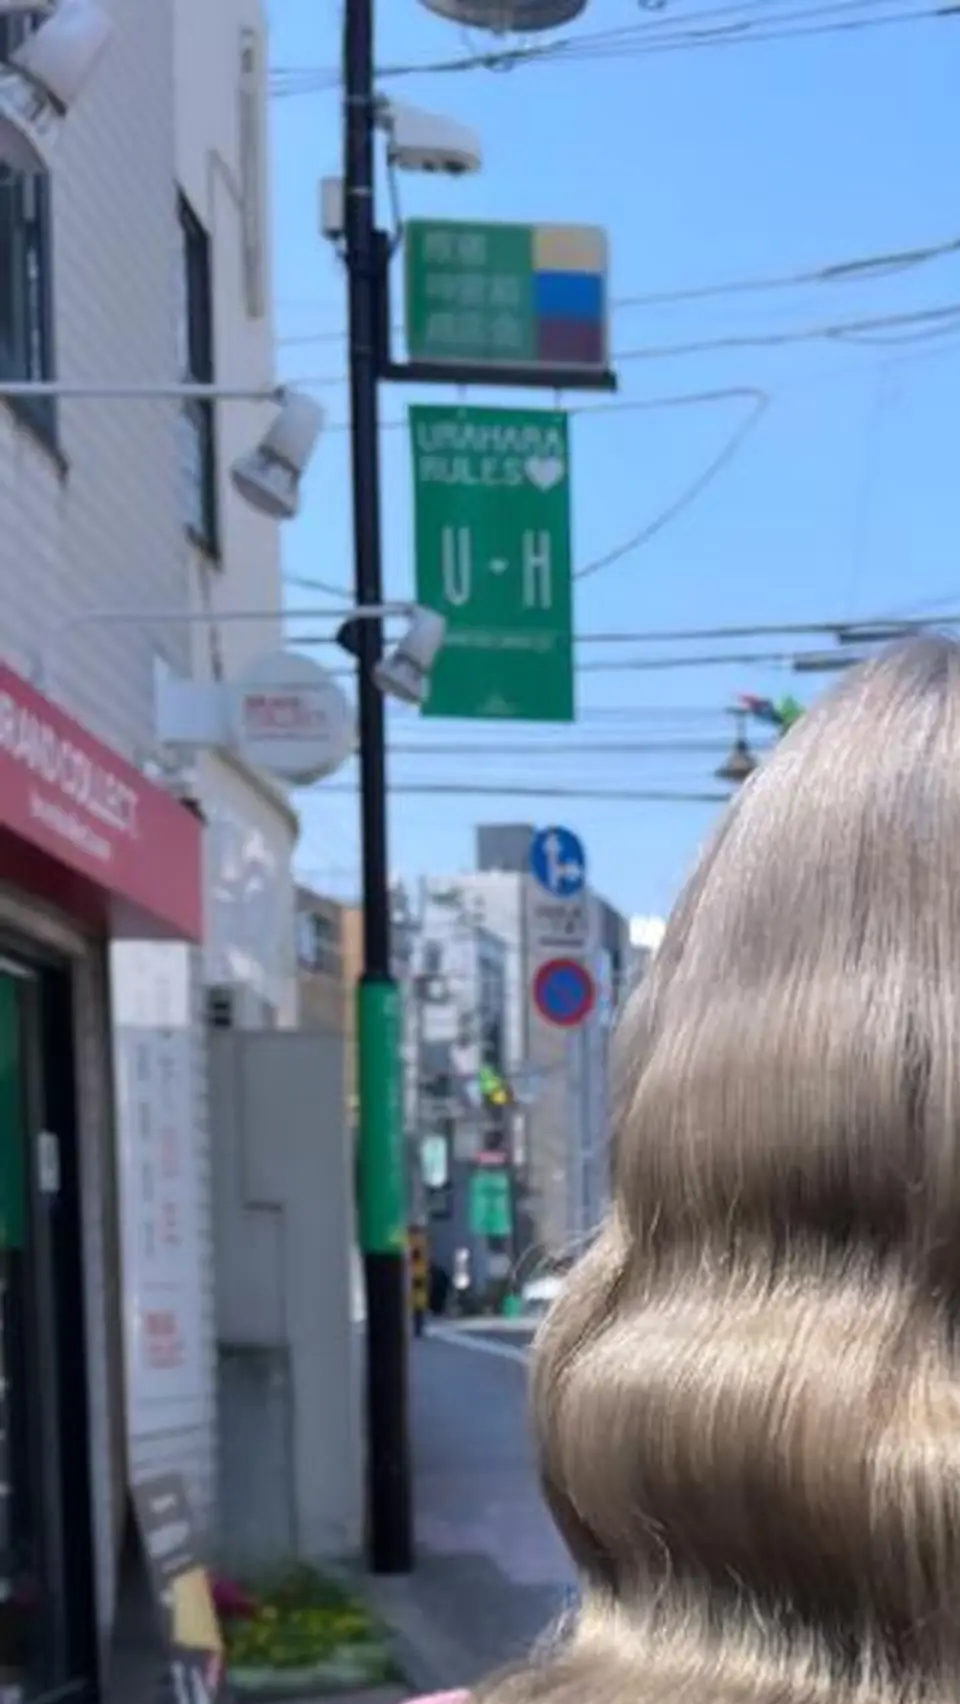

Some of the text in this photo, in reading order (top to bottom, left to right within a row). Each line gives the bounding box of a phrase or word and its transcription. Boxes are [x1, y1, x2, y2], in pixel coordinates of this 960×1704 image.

[418, 423, 561, 454] URAHARA
[420, 456, 523, 485] RULES
[522, 530, 552, 608] H
[60, 738, 138, 840] COLLECT
